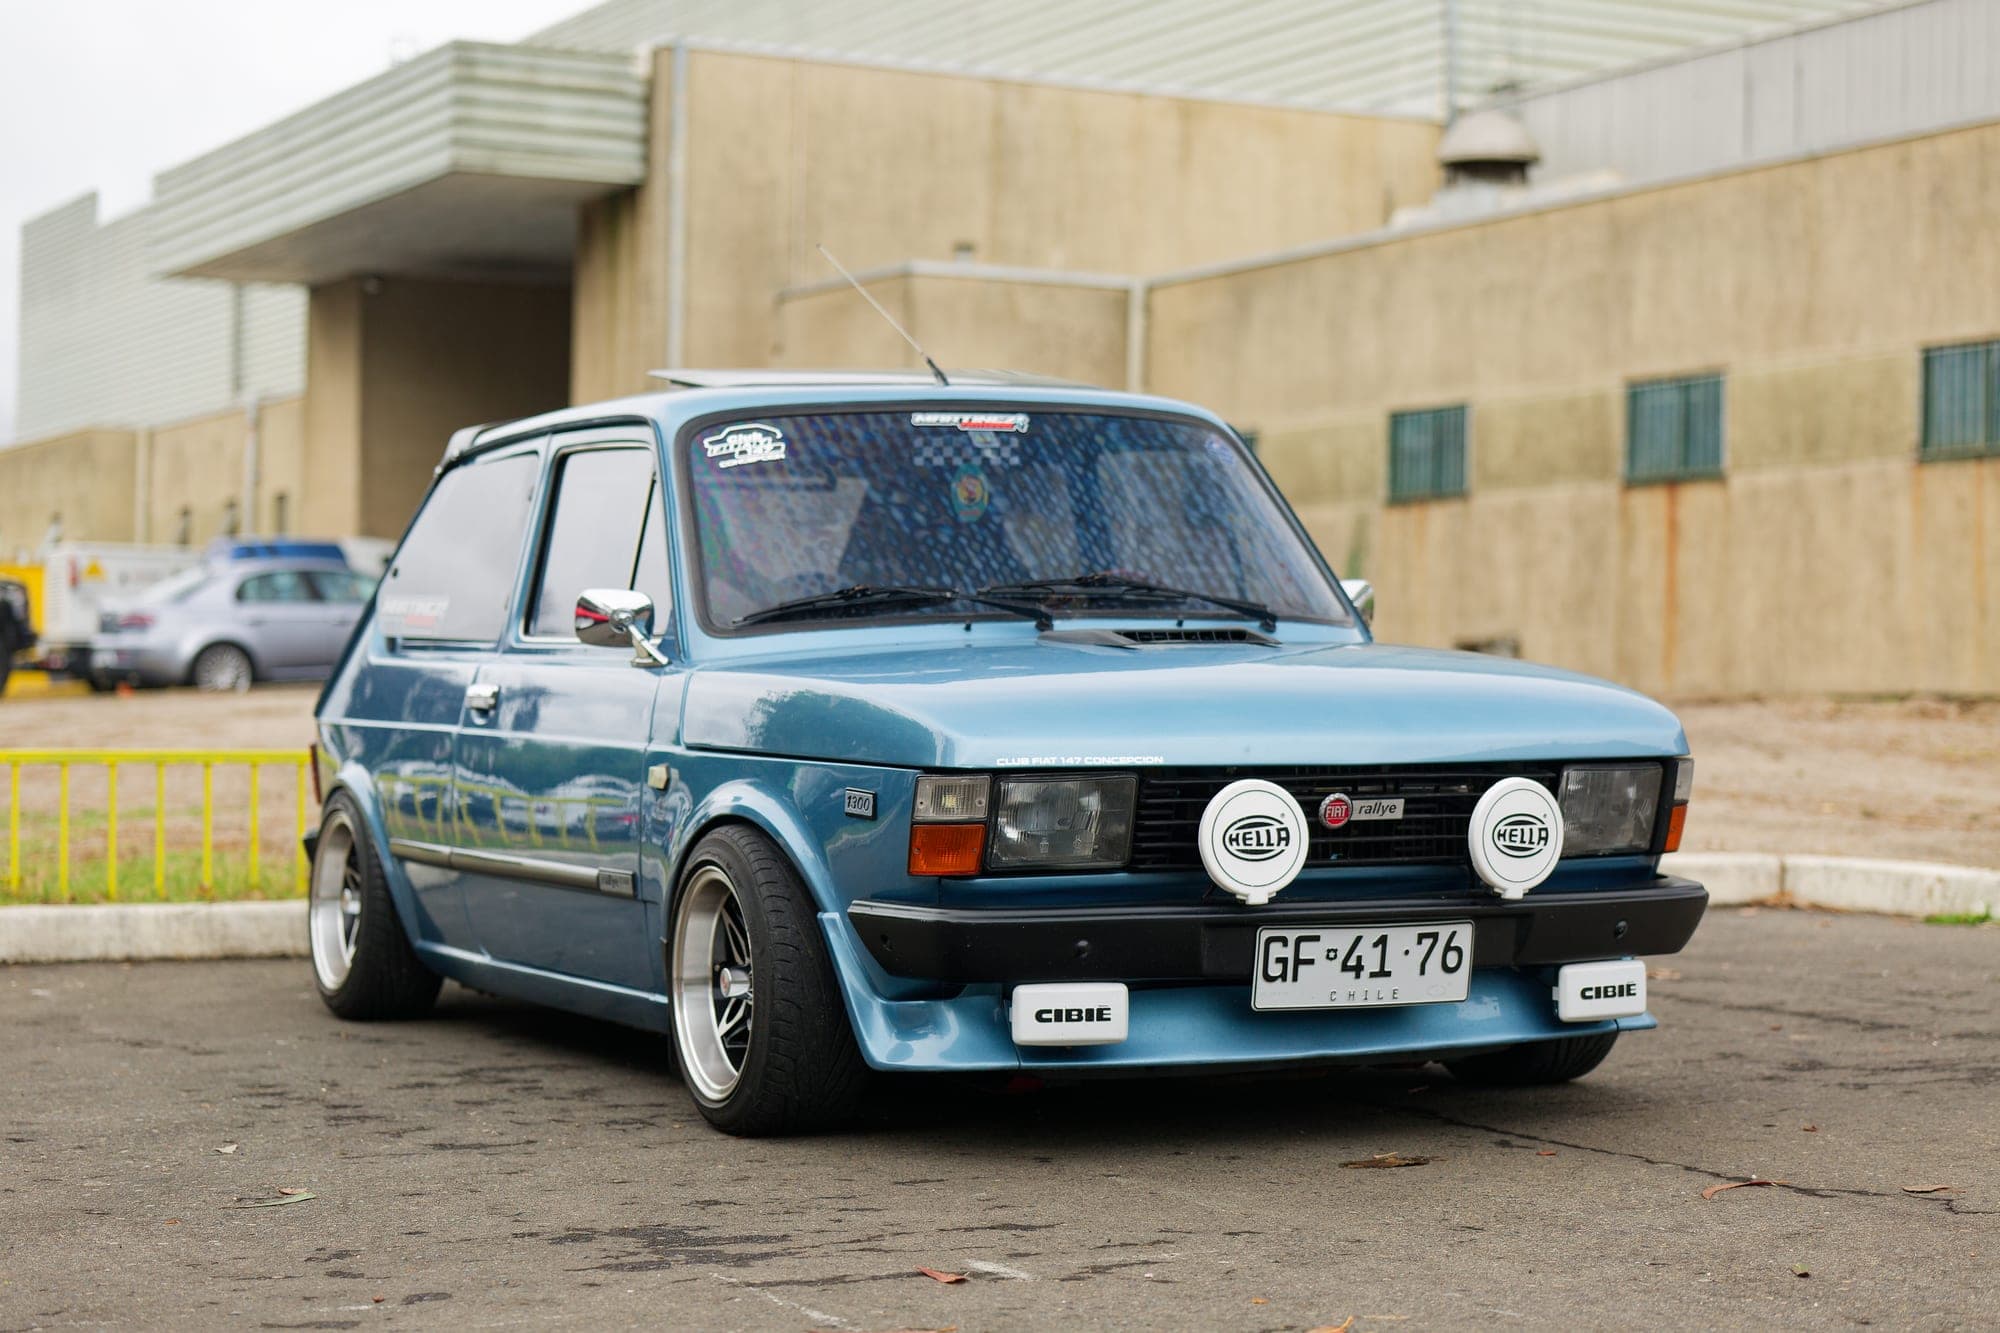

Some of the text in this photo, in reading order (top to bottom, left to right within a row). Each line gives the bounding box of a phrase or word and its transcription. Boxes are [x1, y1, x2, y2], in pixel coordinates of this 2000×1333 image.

[996, 756, 1164, 766] CLUB FIAT 147 CONCEPCION
[847, 795, 870, 811] 1300
[1325, 802, 1397, 818] FIAT rallye
[1228, 826, 1291, 847] HELLA
[1497, 827, 1549, 847] HELLA
[1329, 988, 1399, 1001] CHILE
